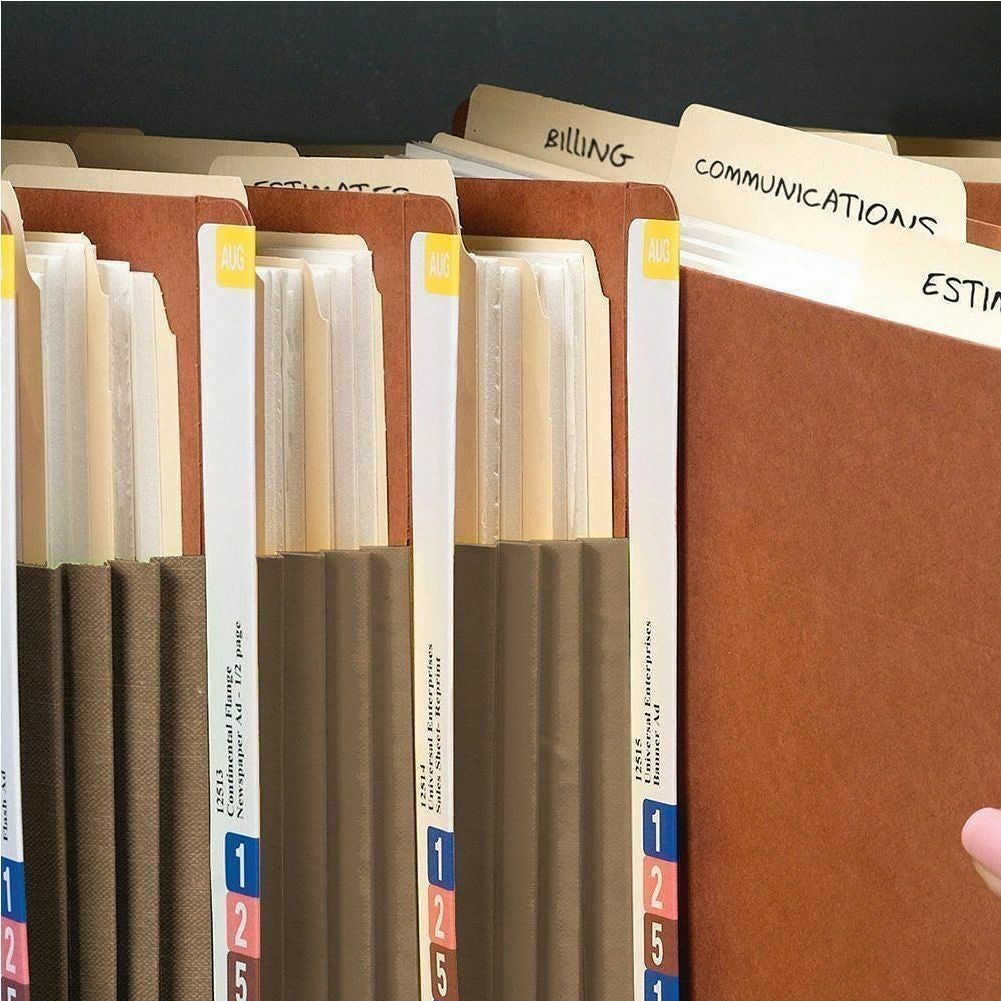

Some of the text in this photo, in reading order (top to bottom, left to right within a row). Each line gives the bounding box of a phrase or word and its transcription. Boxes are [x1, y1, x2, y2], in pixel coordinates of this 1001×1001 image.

[544, 126, 634, 167] BILLING
[695, 158, 938, 236] COMMUNICATIONS
[221, 244, 245, 270] AUG
[430, 252, 450, 278] AUG
[648, 238, 670, 262] AUG
[234, 621, 243, 658] page
[234, 664, 242, 685] 1/2
[644, 621, 652, 707] Enterprises
[234, 703, 242, 726] Ad
[653, 704, 660, 727] Ad
[225, 666, 234, 817] Continental Flange
[216, 769, 224, 814] 12513
[235, 730, 244, 819] Newspaper
